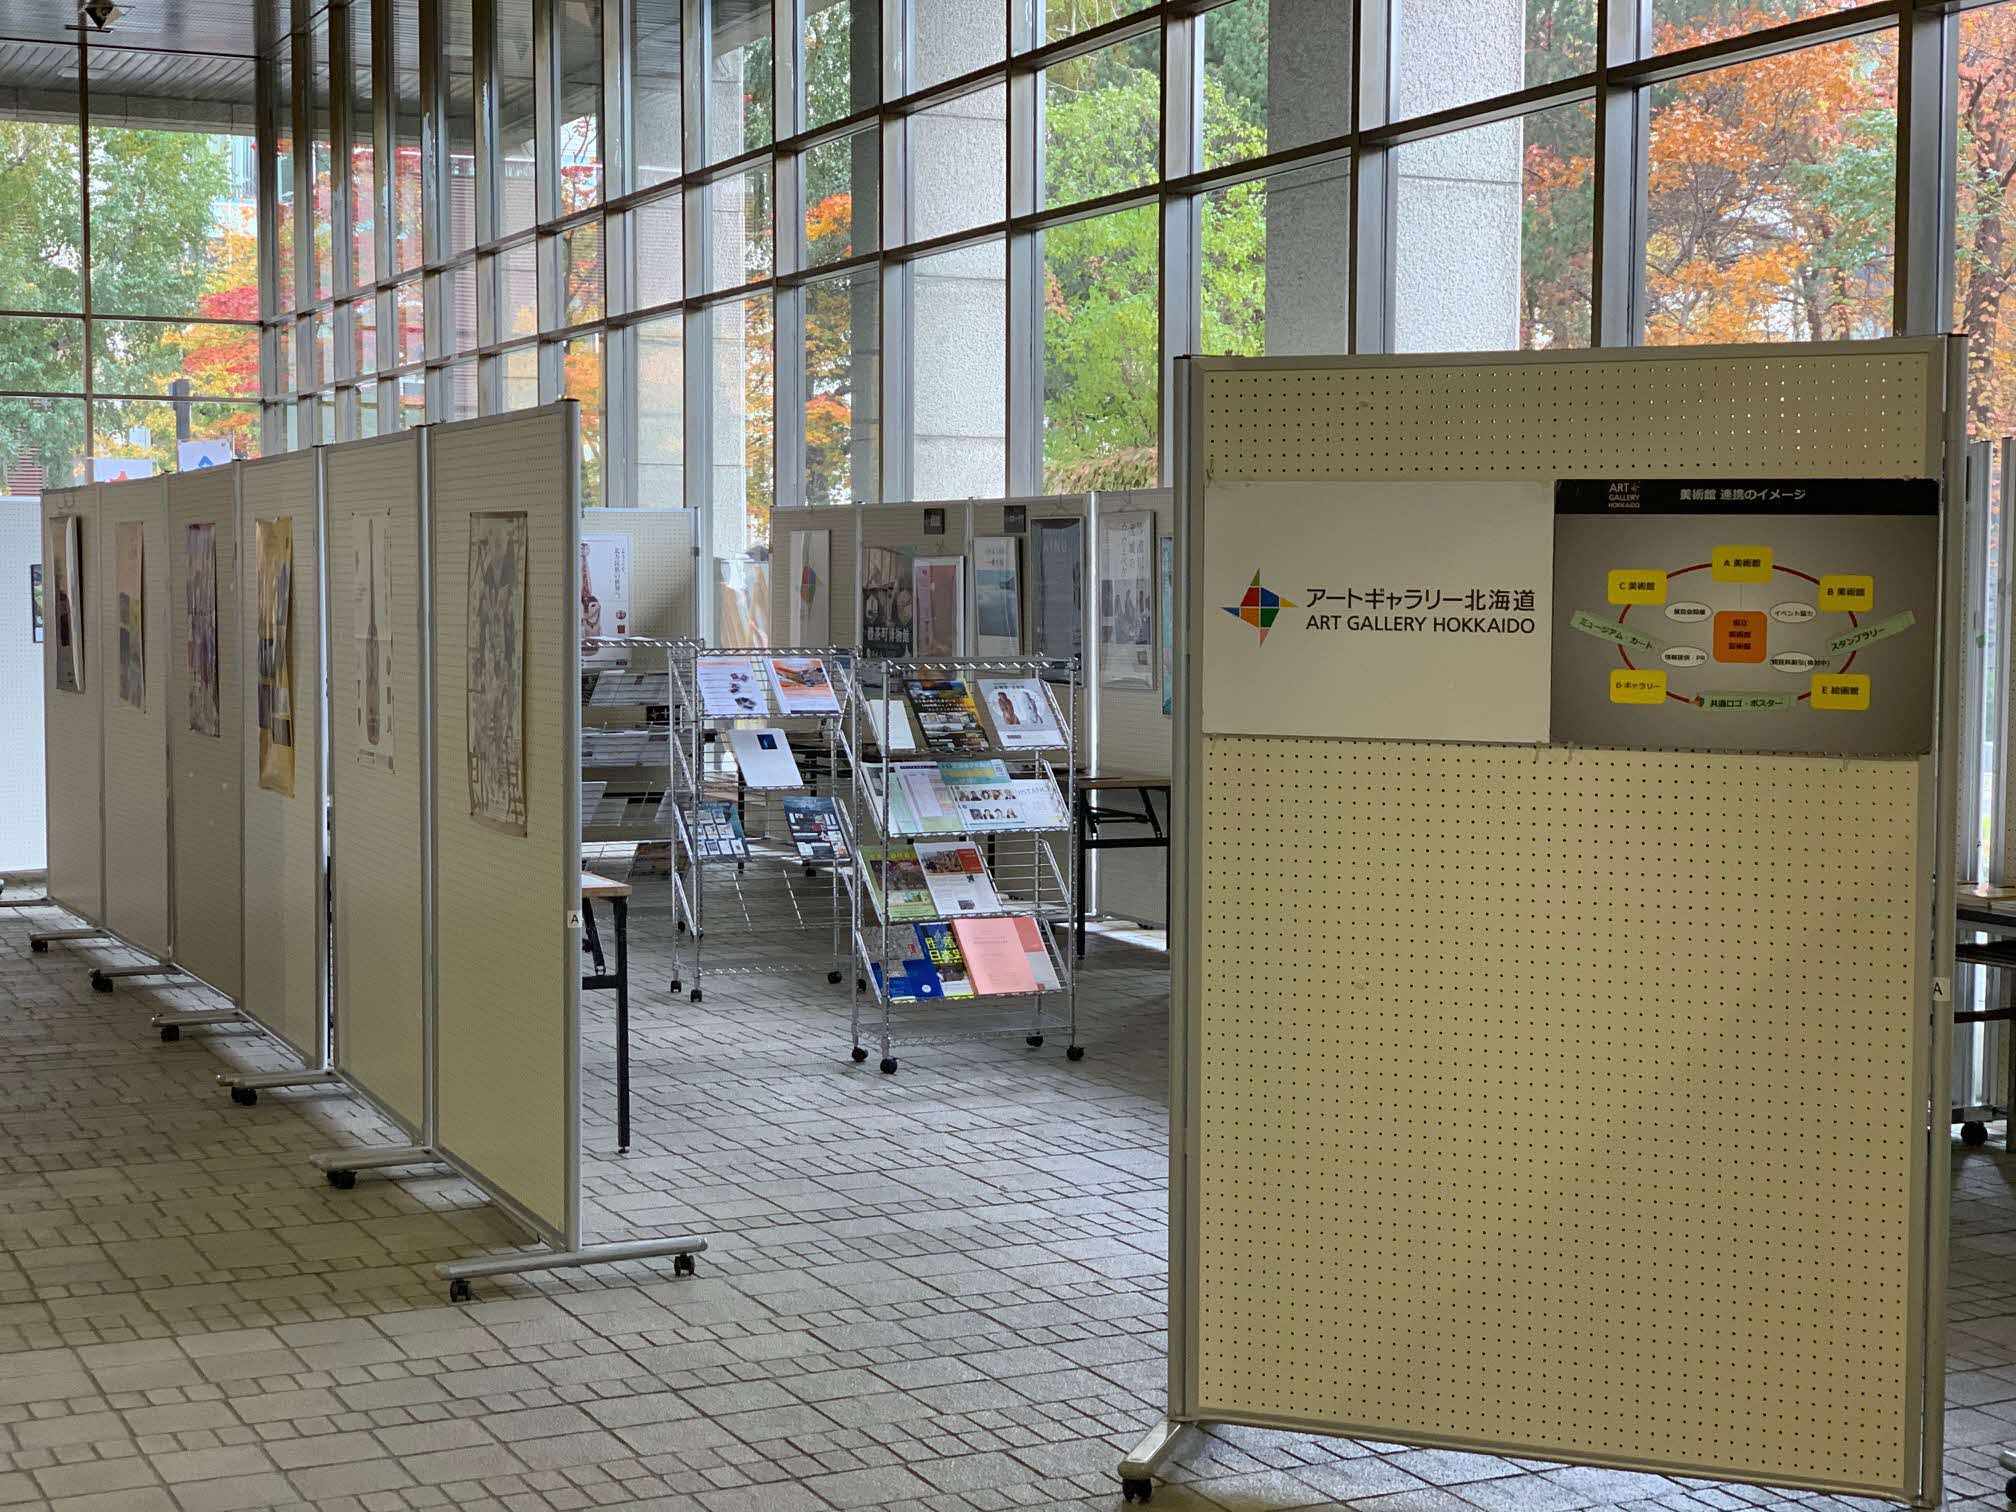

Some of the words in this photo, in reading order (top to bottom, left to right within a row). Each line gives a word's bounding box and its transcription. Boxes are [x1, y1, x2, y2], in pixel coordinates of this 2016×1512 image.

[1609, 483, 1628, 492] ART
[1680, 488, 1716, 500] 美術館
[1720, 488, 1806, 500] 連携のイメージ
[1723, 559, 1730, 567] A
[1628, 581, 1656, 591] 美術館
[1827, 588, 1834, 596] B
[1306, 588, 1536, 611] アートギャラリー北海道
[1306, 615, 1341, 630] ART
[1347, 616, 1427, 632] GALLERY
[1433, 617, 1535, 634] HOKKAIDO
[1831, 628, 1886, 652] スタンプラリー
[1624, 681, 1662, 690] ギャラリー
[571, 914, 579, 924] A
[1933, 981, 1943, 996] A
